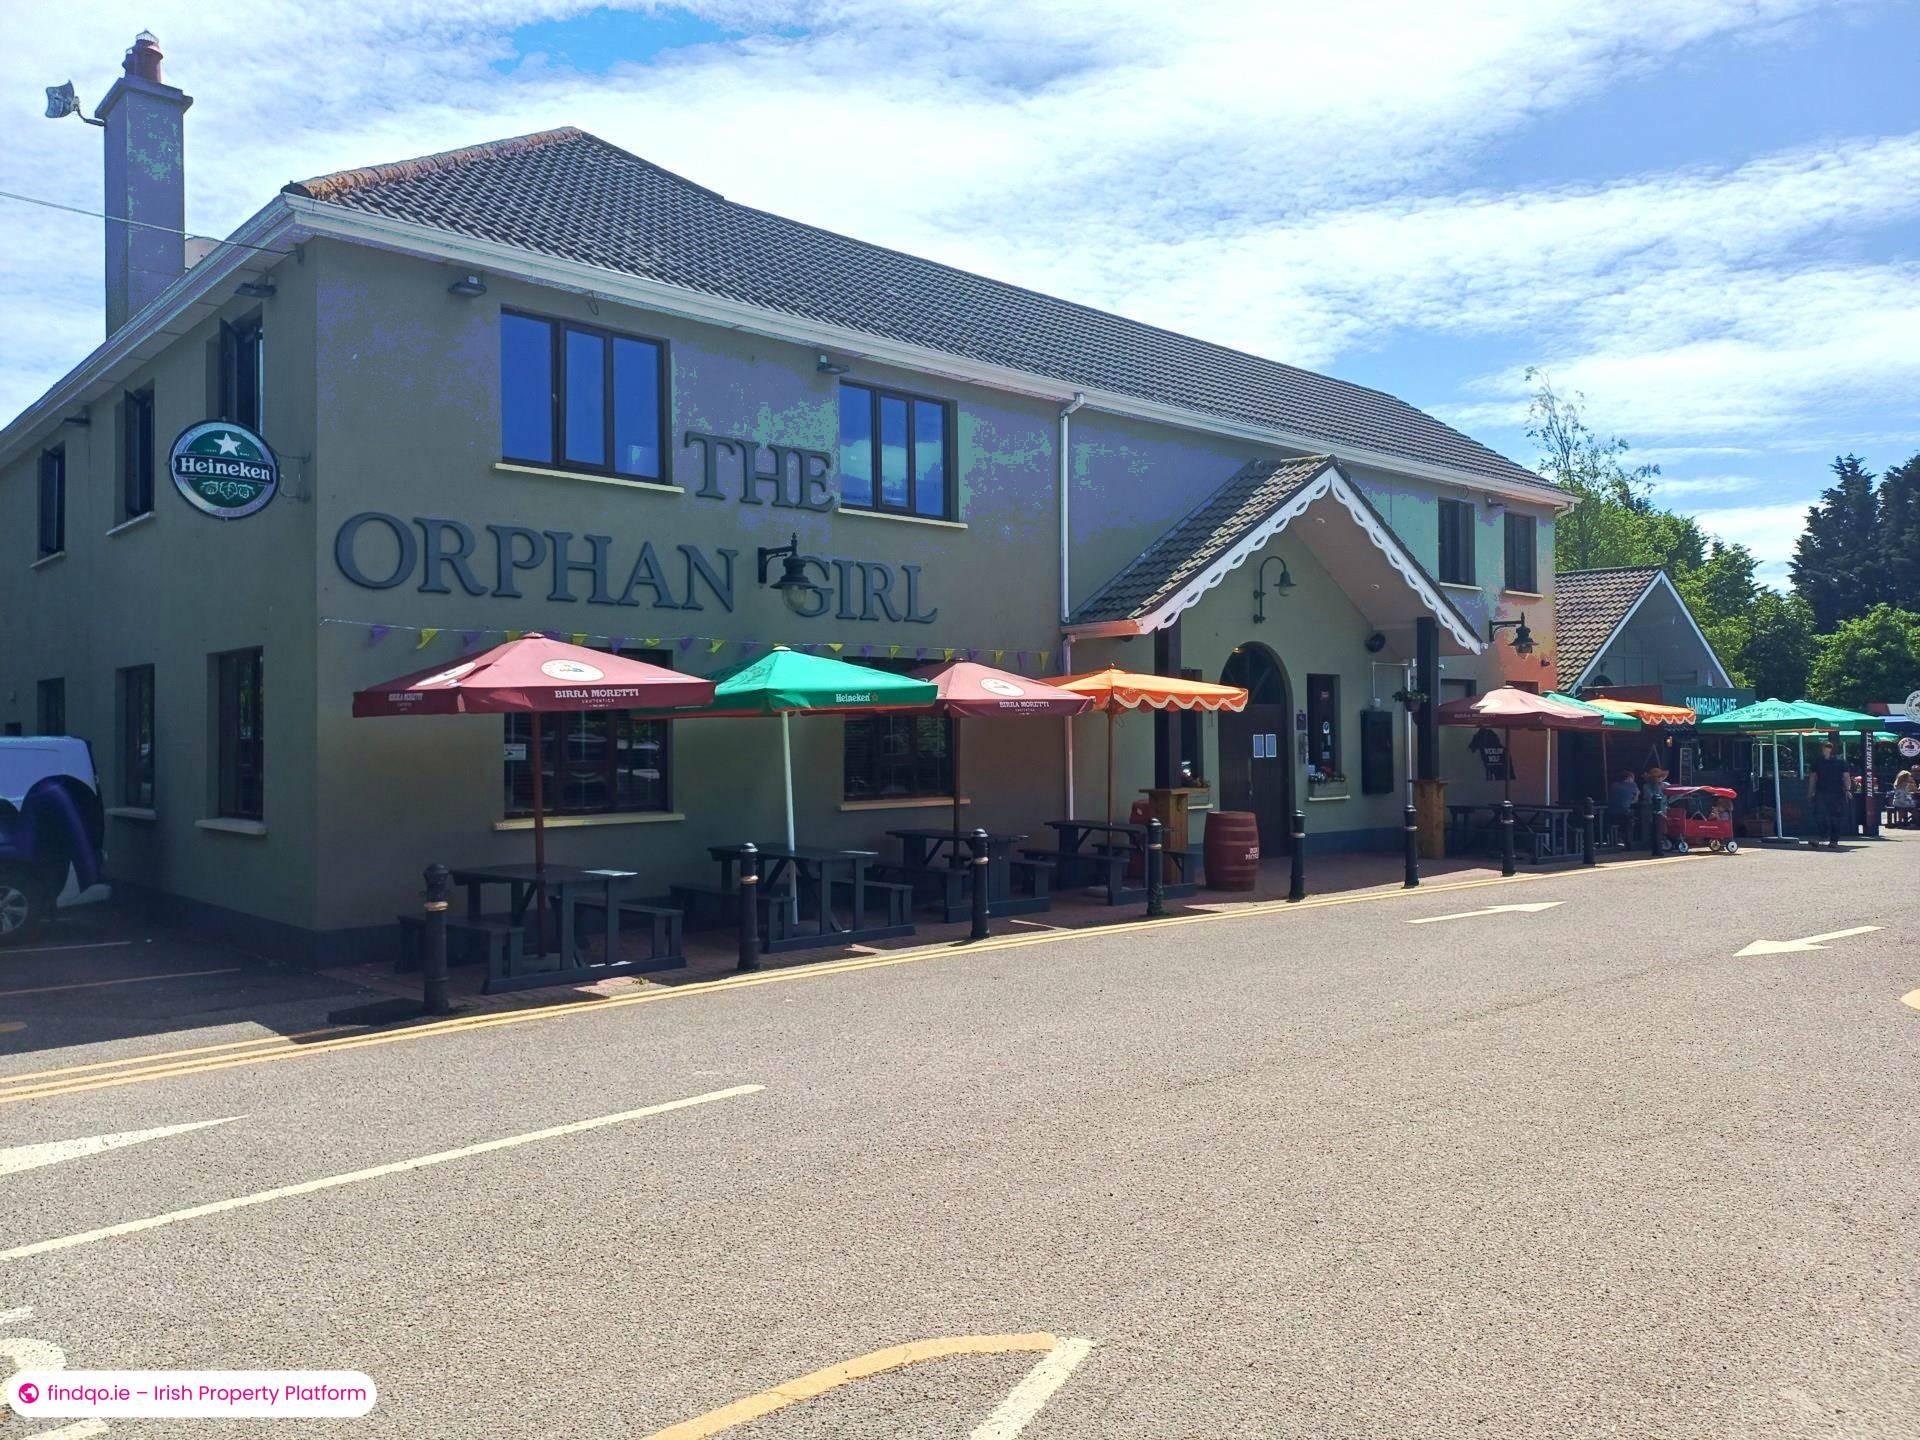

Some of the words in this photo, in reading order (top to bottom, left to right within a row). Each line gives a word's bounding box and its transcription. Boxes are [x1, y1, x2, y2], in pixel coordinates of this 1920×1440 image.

[180, 457, 271, 481] Heineken
[684, 430, 838, 513] THE
[334, 511, 738, 613] ORPHAN
[792, 554, 939, 625] GIRL
[554, 690, 589, 698] BIRRA
[591, 688, 639, 697] MORETTI
[835, 693, 871, 703] Heineken
